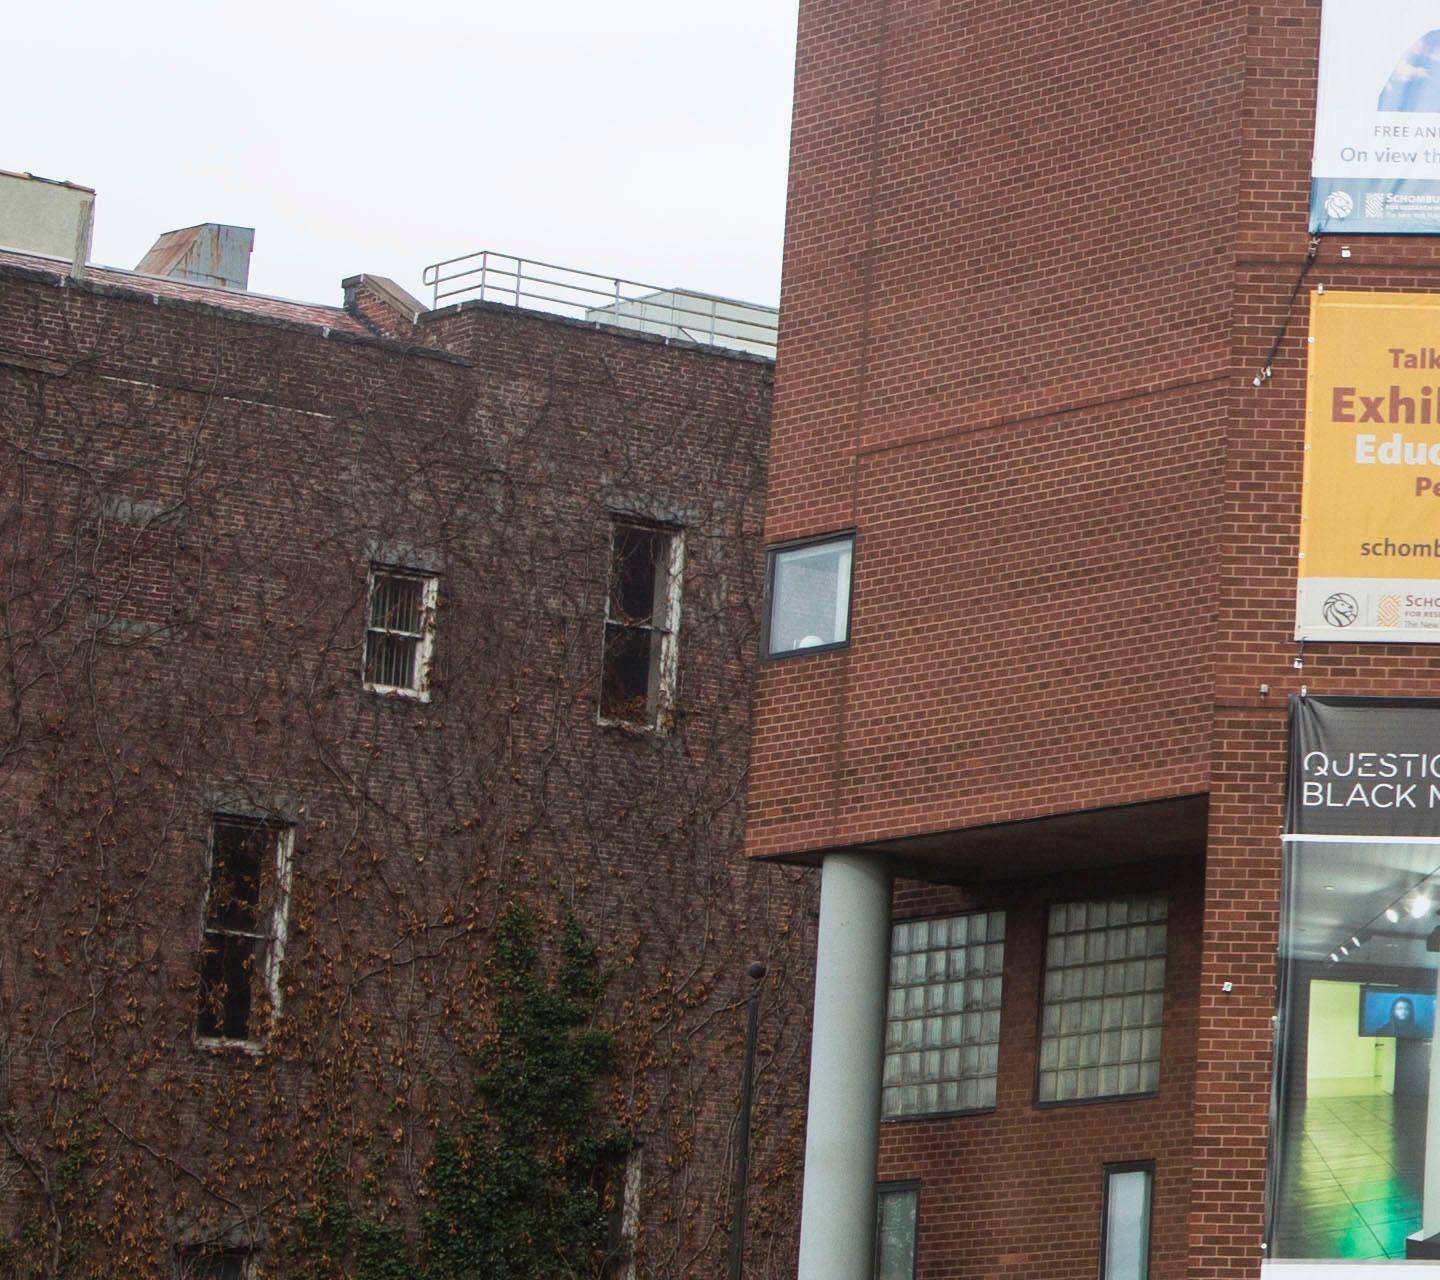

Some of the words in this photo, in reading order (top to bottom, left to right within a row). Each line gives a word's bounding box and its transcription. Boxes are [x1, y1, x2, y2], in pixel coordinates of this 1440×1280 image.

[1374, 125, 1411, 139] FREE
[1340, 146, 1368, 165] On
[1374, 146, 1418, 164] view
[1303, 782, 1417, 808] BLACK
